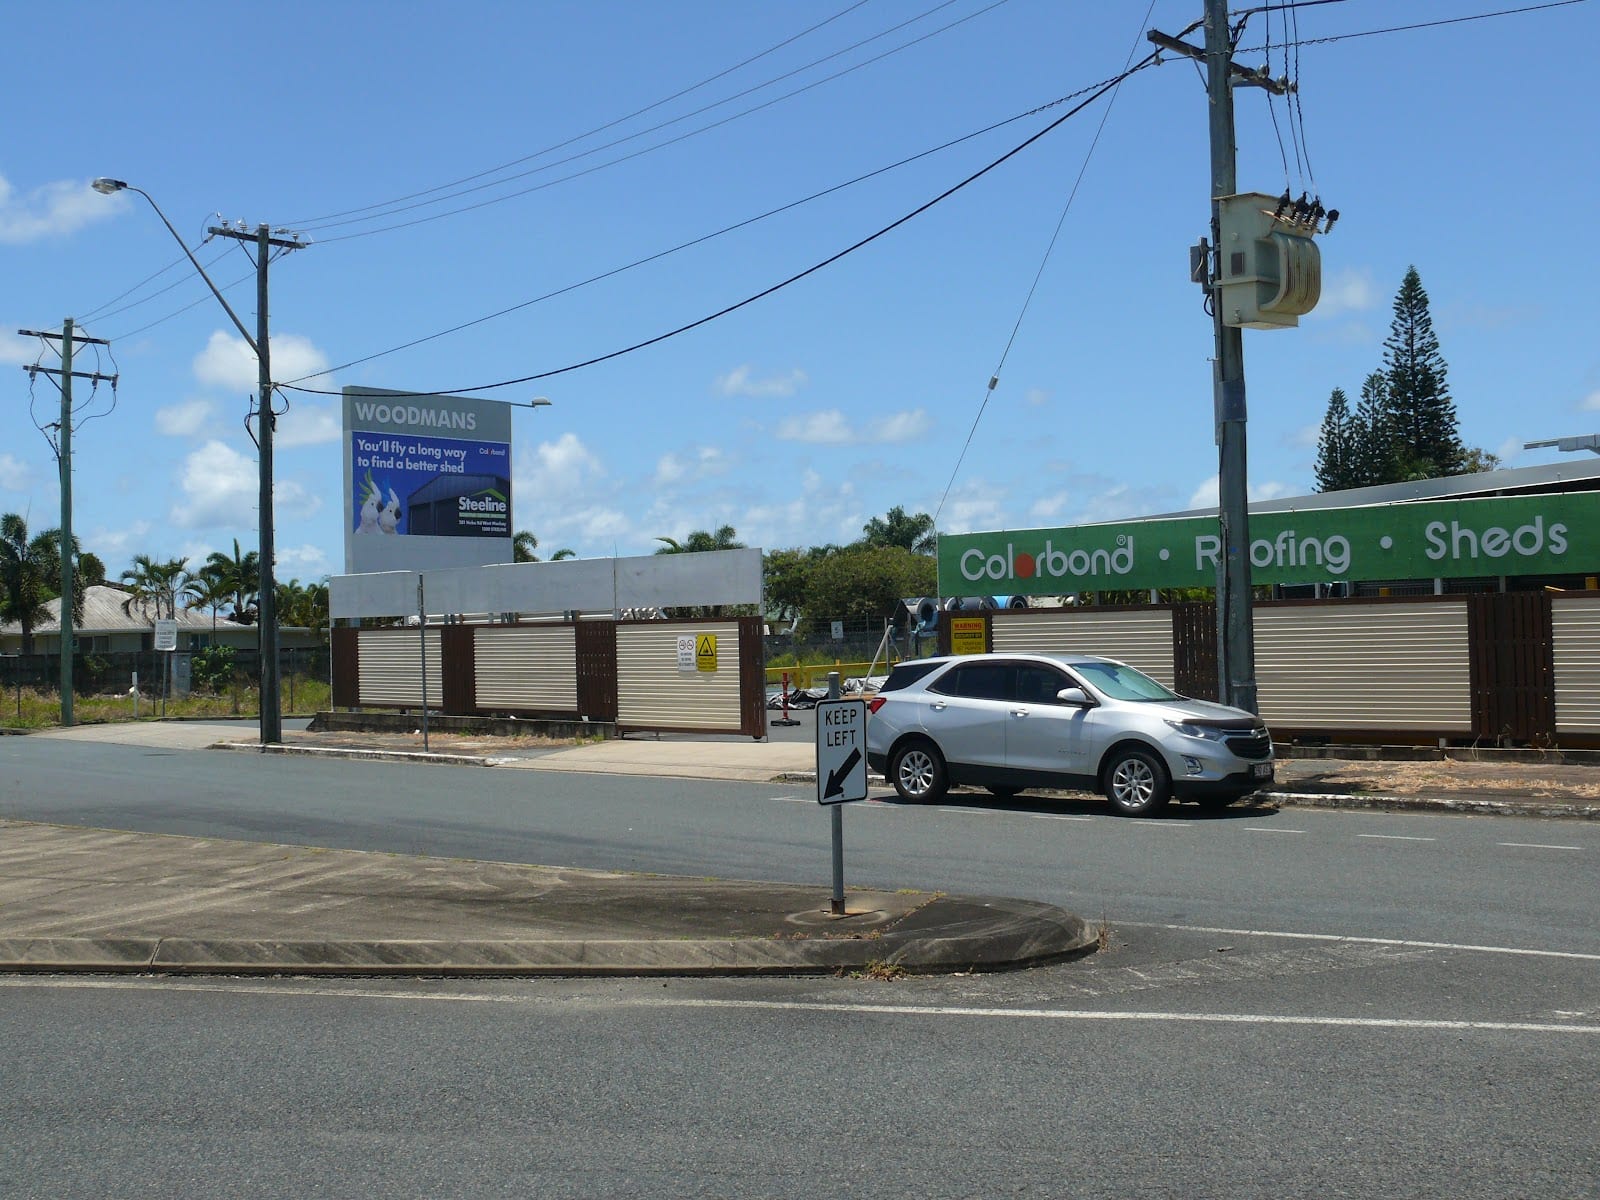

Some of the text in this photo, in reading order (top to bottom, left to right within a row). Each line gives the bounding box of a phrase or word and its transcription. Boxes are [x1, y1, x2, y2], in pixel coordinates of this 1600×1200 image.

[355, 402, 476, 430] WOODMANS
[357, 439, 467, 461] You'll fly a long way
[357, 456, 464, 474] to find a better shed
[459, 496, 507, 511] Steeline
[1195, 530, 1350, 574] Rofing
[1424, 515, 1568, 560] Sheds
[954, 622, 982, 630] WARNING
[825, 709, 857, 726] KEEP
[827, 730, 856, 747] LEFT
